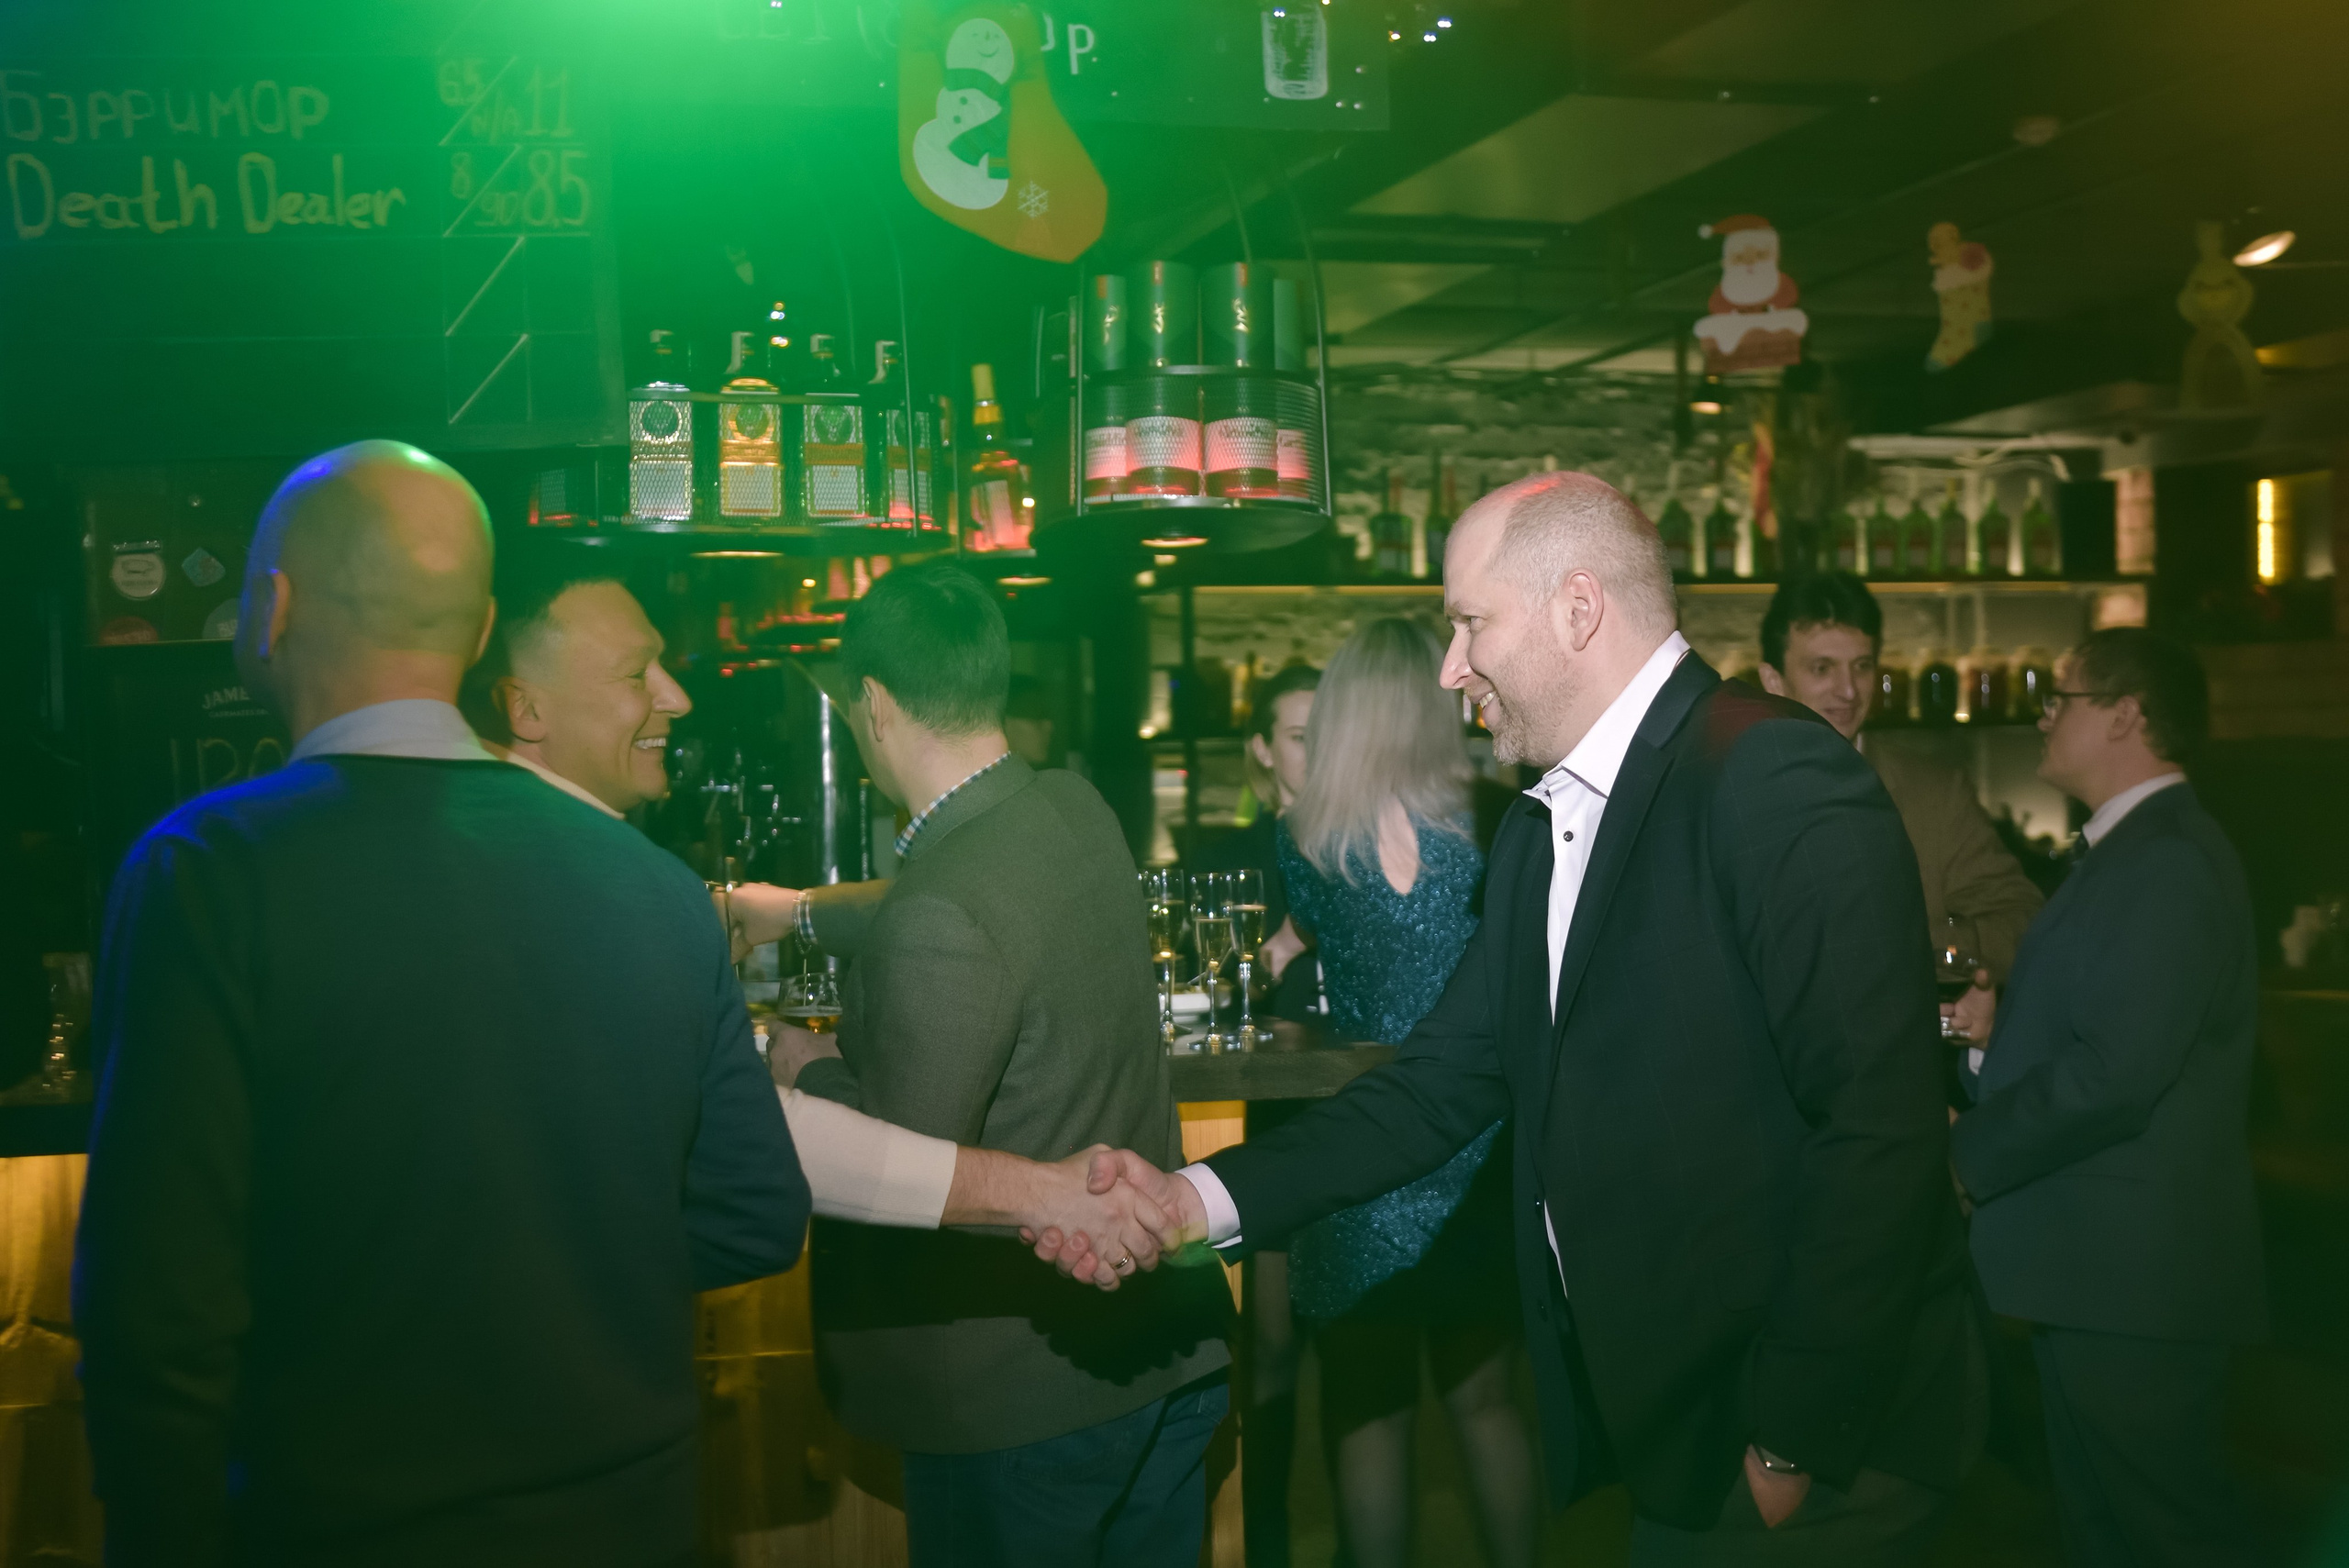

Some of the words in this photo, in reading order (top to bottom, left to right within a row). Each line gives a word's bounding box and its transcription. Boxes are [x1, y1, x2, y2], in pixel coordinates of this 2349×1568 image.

[524, 64, 575, 139] 11
[6, 152, 217, 239] Death
[238, 150, 406, 234] Dealer
[449, 151, 473, 200] 8
